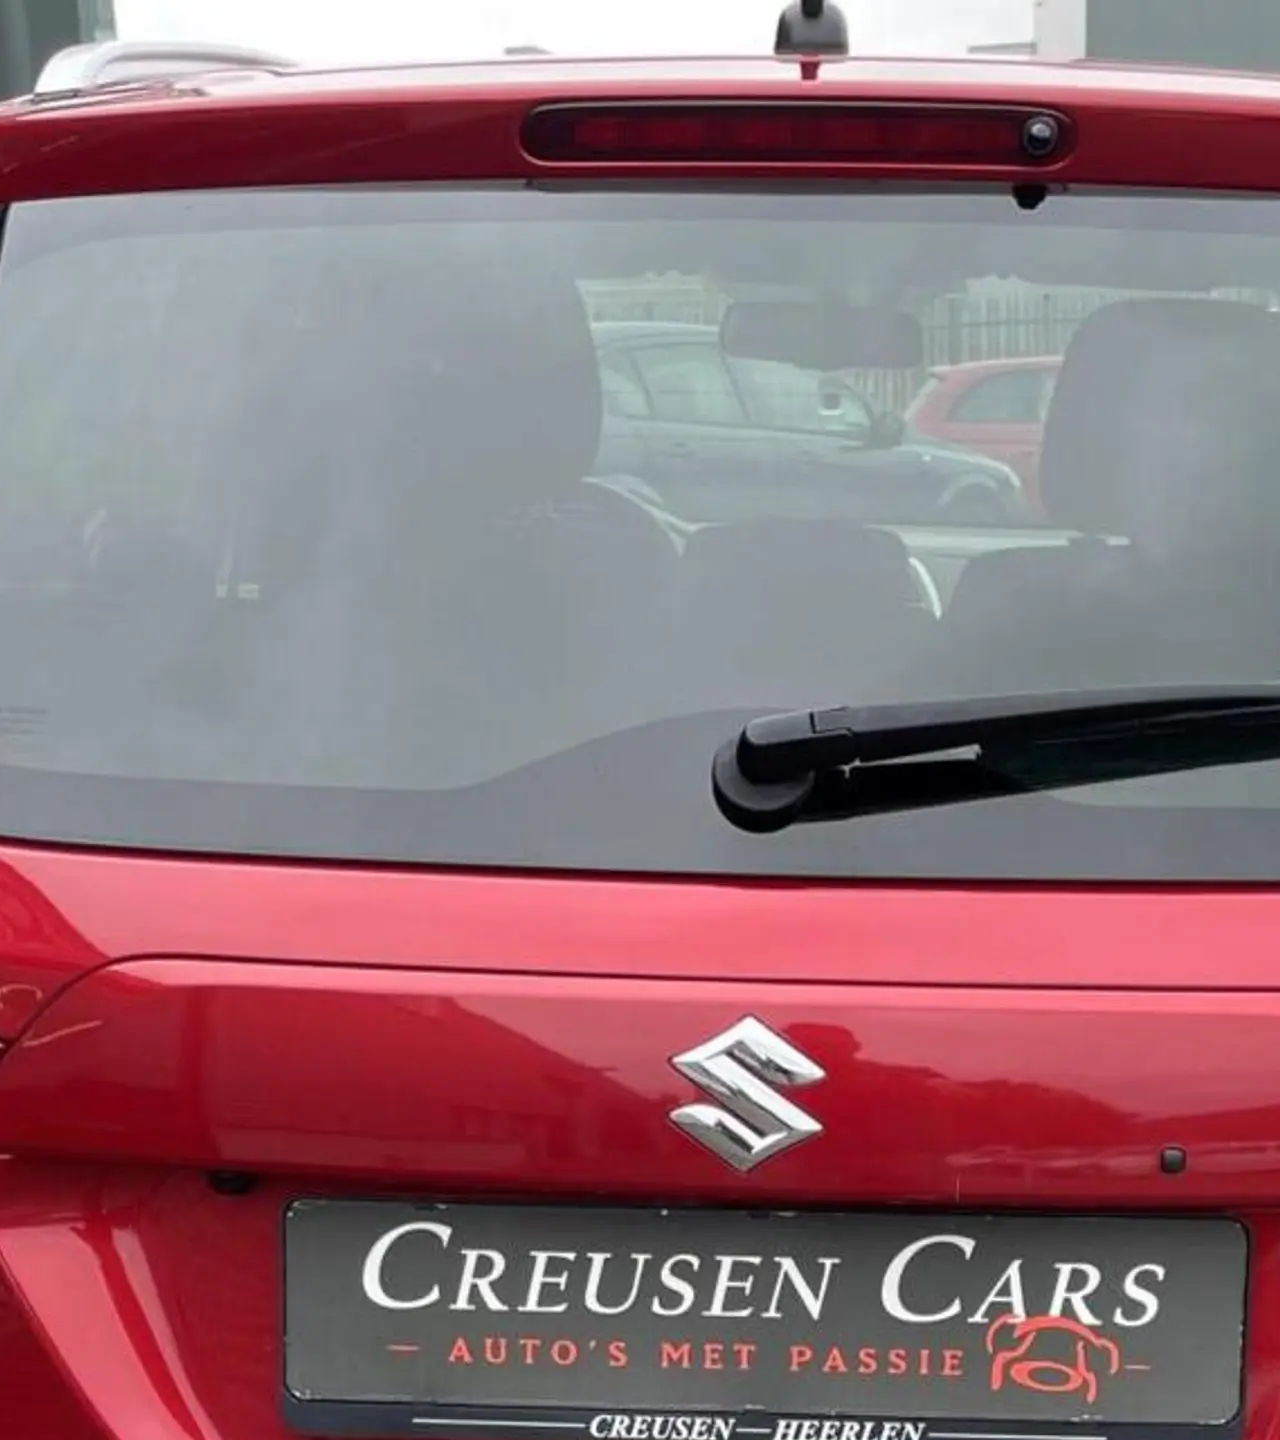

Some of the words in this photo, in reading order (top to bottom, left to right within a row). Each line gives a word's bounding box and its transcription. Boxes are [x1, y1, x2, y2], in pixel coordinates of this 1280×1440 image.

[362, 1221, 841, 1321] CREUSEN
[881, 1234, 1167, 1327] CARS
[447, 1336, 629, 1369] AUTO'S
[660, 1341, 757, 1371] MET
[788, 1344, 965, 1377] PASSIE
